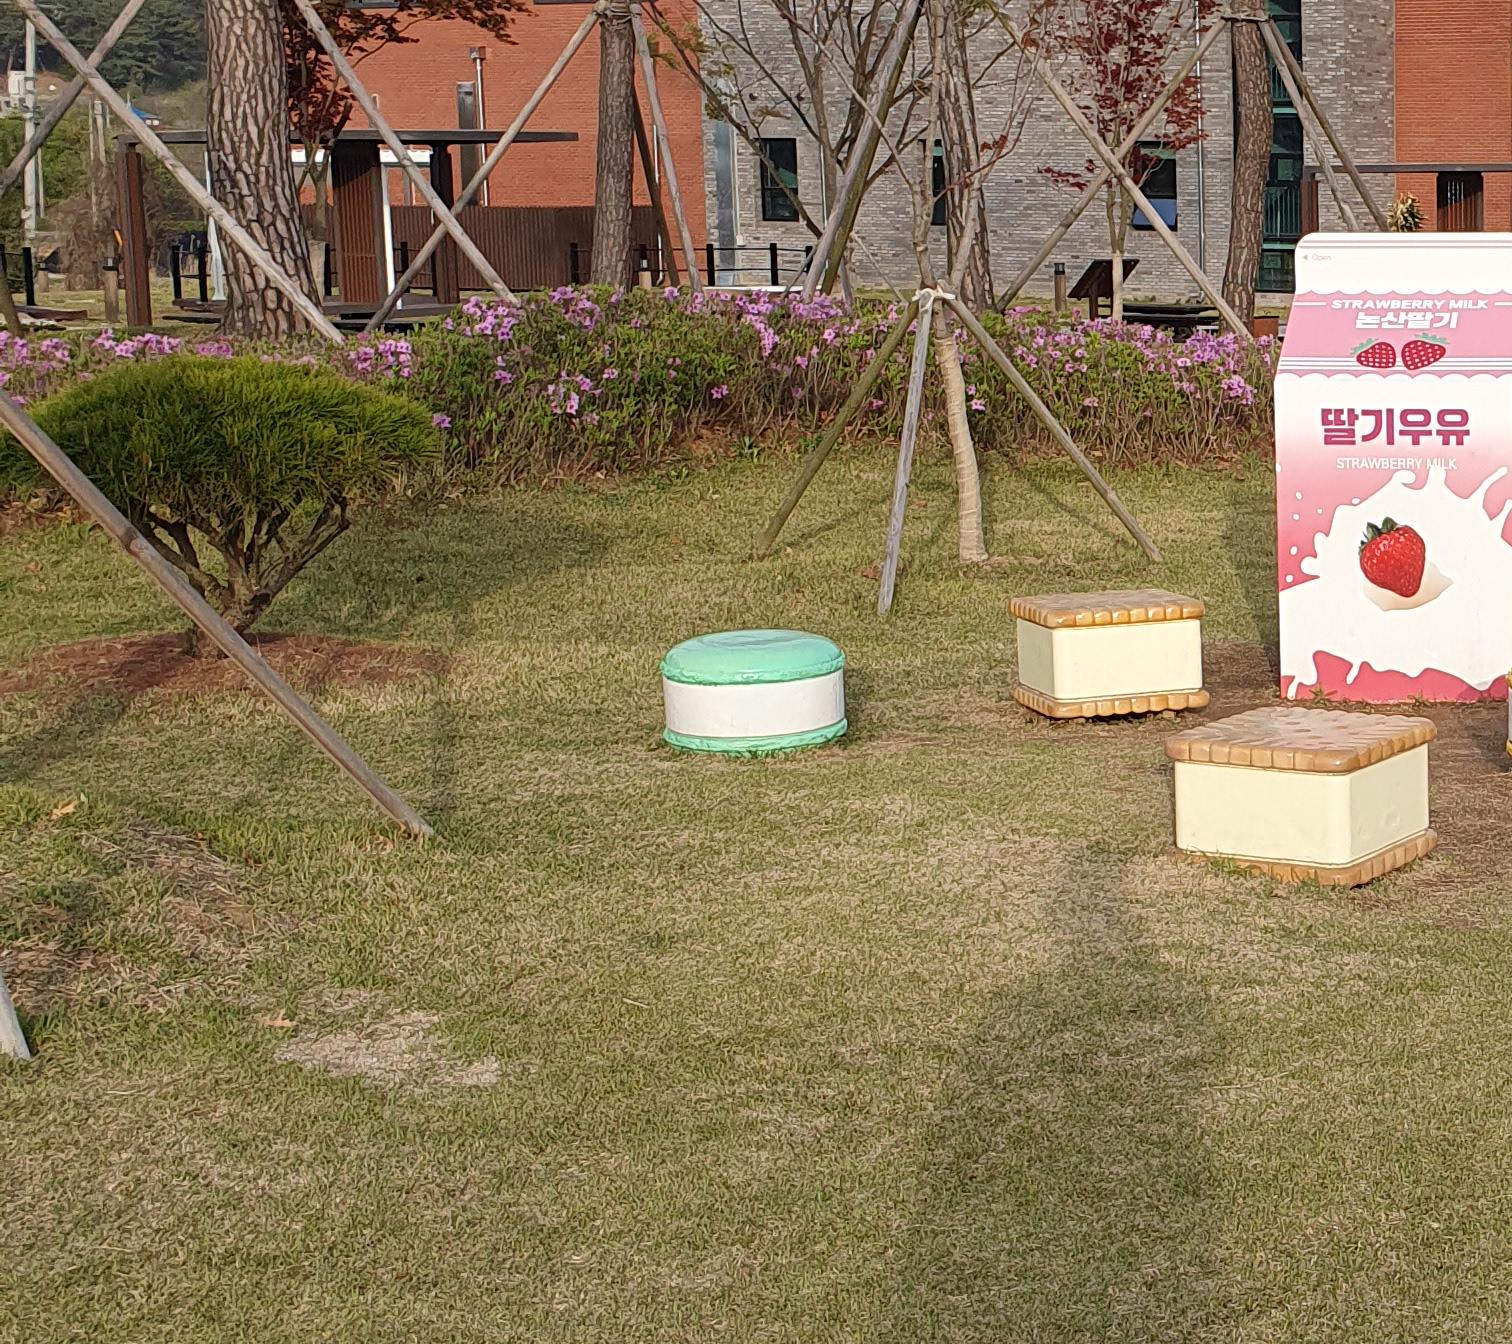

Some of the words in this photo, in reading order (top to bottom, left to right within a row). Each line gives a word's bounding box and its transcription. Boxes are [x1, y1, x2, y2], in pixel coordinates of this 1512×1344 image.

[1331, 299, 1446, 310] STRAWBERRY
[1448, 299, 1489, 310] MILK
[1355, 311, 1459, 329] 논산딸기
[1321, 408, 1470, 446] 딸기우유
[1336, 457, 1423, 470] STRAWBERRY
[1426, 457, 1457, 470] MILK
